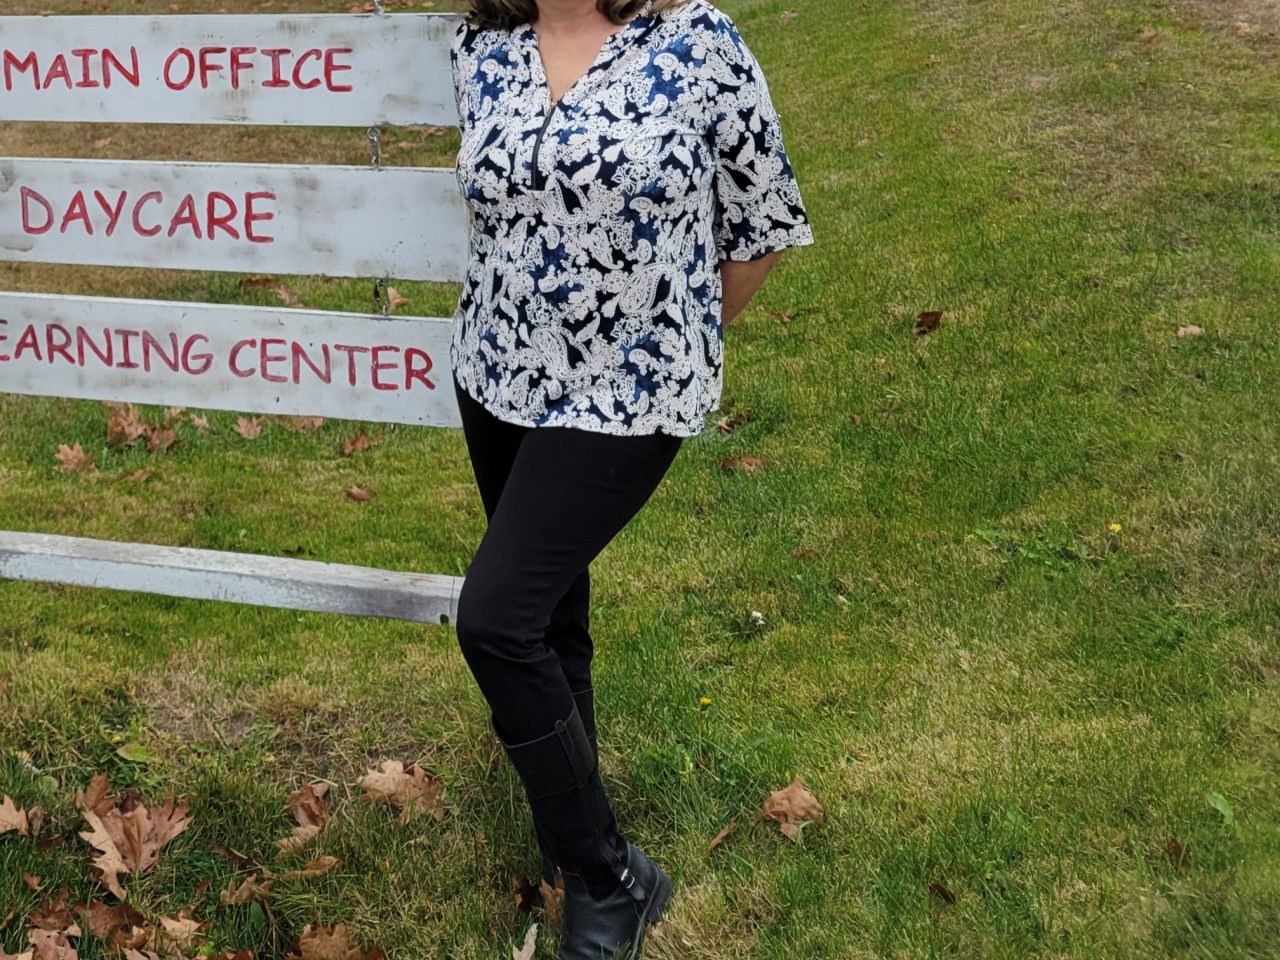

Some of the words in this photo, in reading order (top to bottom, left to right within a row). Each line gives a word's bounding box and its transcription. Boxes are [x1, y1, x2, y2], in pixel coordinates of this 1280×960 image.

[2, 46, 141, 92] MAIN
[162, 46, 354, 93] OFFICE
[20, 185, 276, 244] DAYCARE
[228, 338, 436, 391] CENTER
